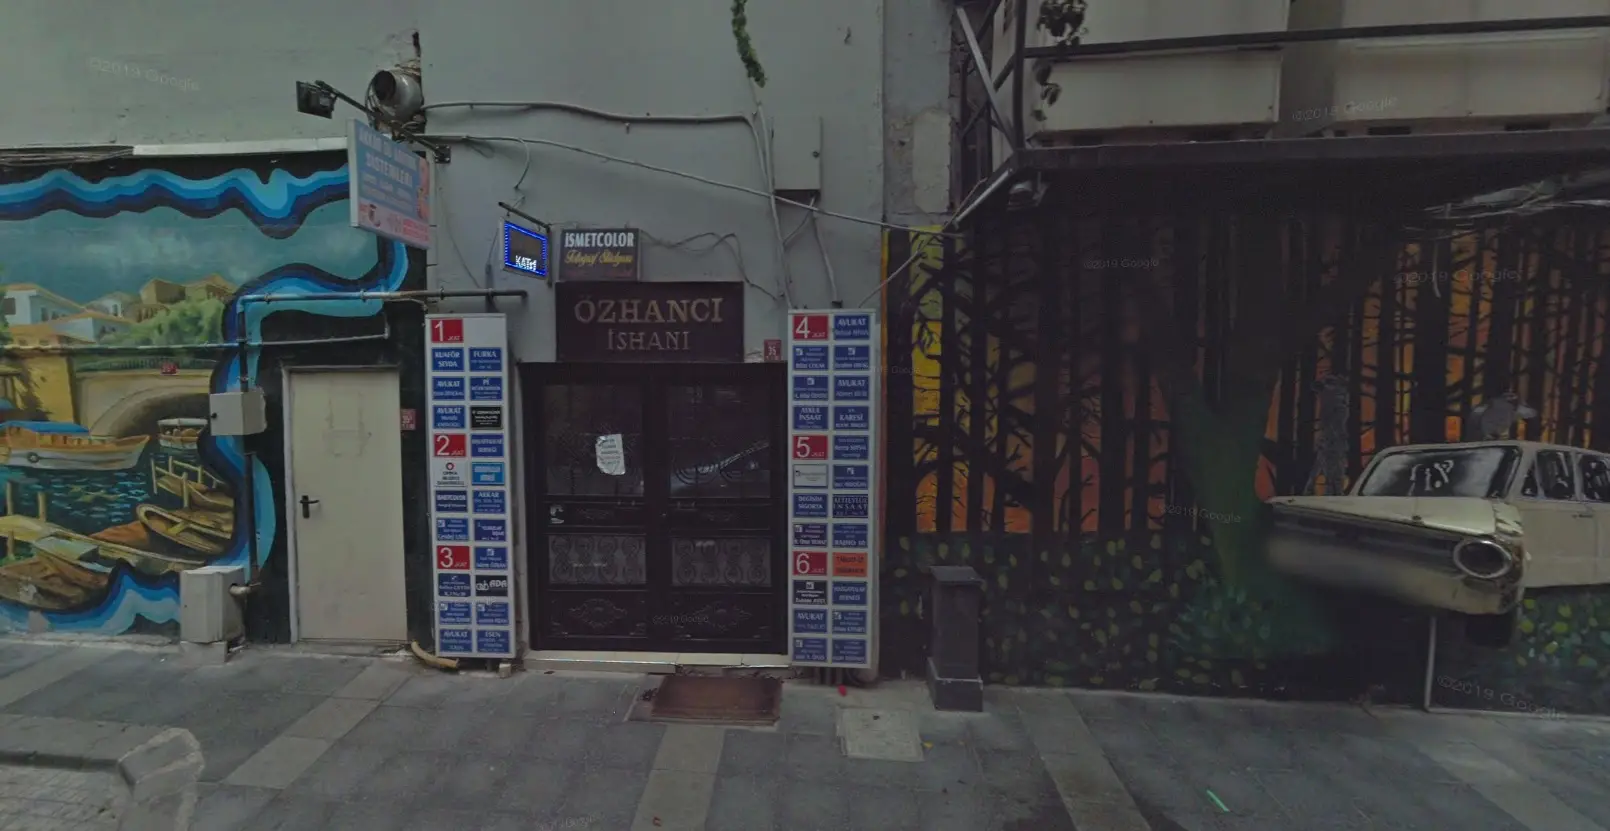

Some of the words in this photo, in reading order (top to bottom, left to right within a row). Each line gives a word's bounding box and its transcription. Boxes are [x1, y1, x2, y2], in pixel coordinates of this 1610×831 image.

[574, 294, 723, 323] ÖZHANCI
[434, 320, 444, 342] 1
[796, 316, 811, 339] 4
[436, 435, 450, 456] 2
[796, 436, 811, 458] 5
[440, 547, 454, 568] 3
[796, 553, 810, 574] 6
